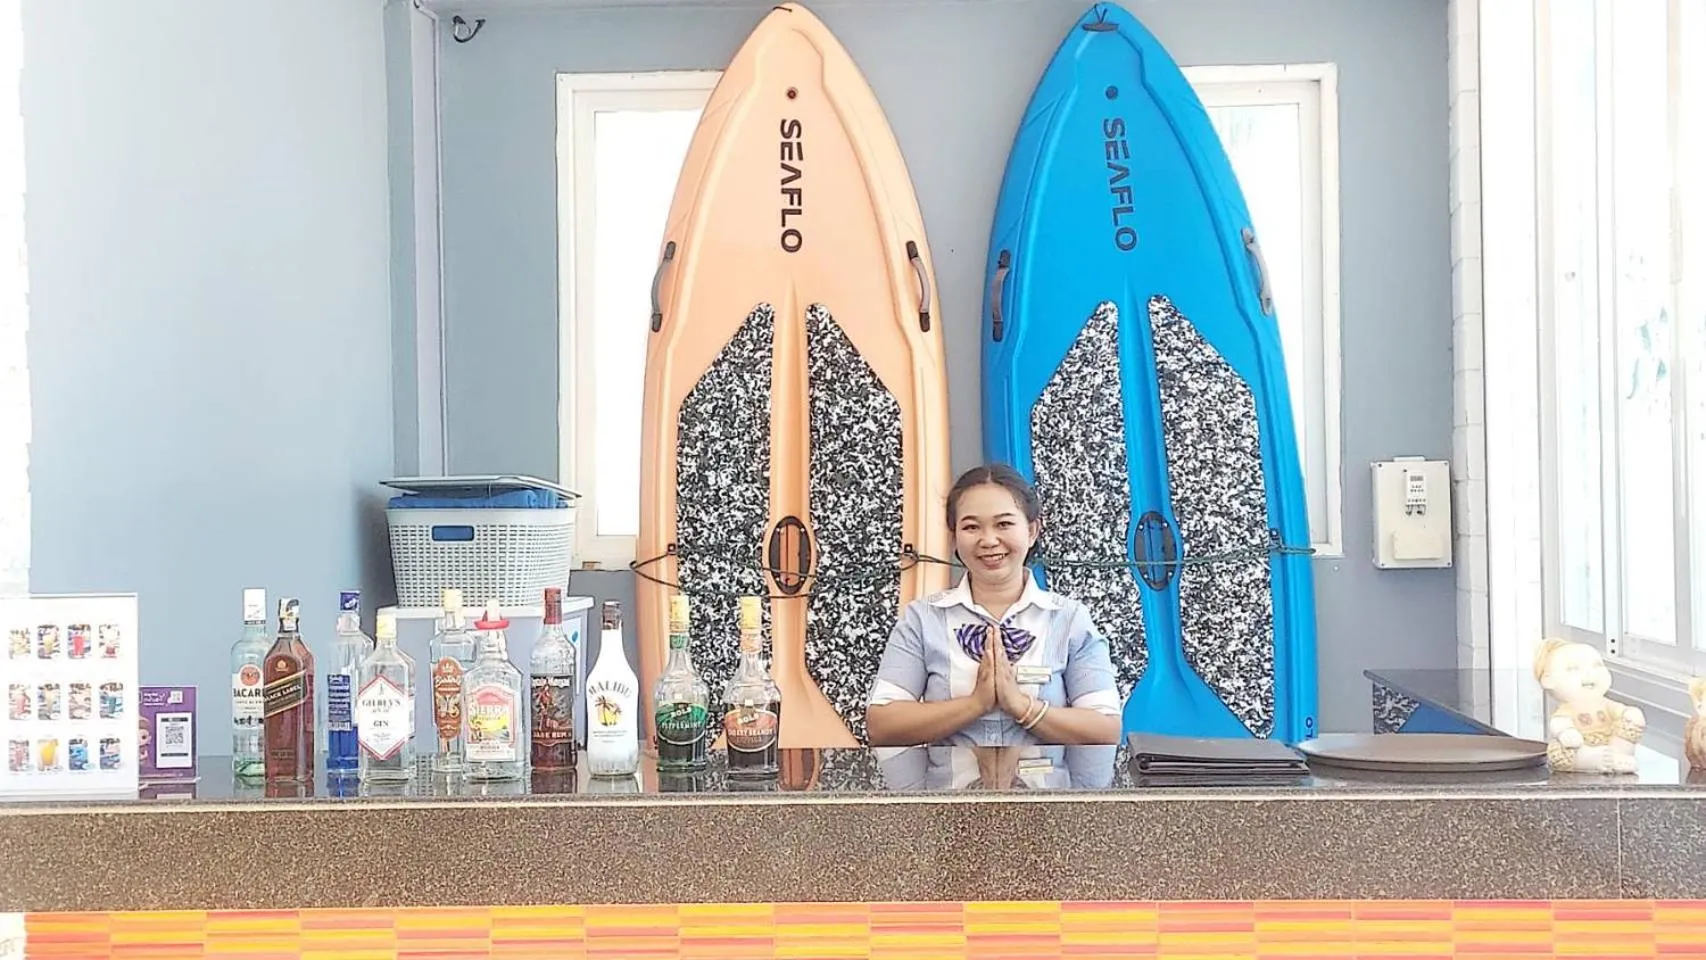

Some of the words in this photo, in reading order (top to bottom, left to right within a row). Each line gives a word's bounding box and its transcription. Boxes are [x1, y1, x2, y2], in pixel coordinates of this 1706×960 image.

[780, 118, 804, 253] SEAFLO
[1103, 117, 1138, 252] SEAFLO
[373, 720, 389, 728] GIN
[588, 681, 632, 698] MALIBU
